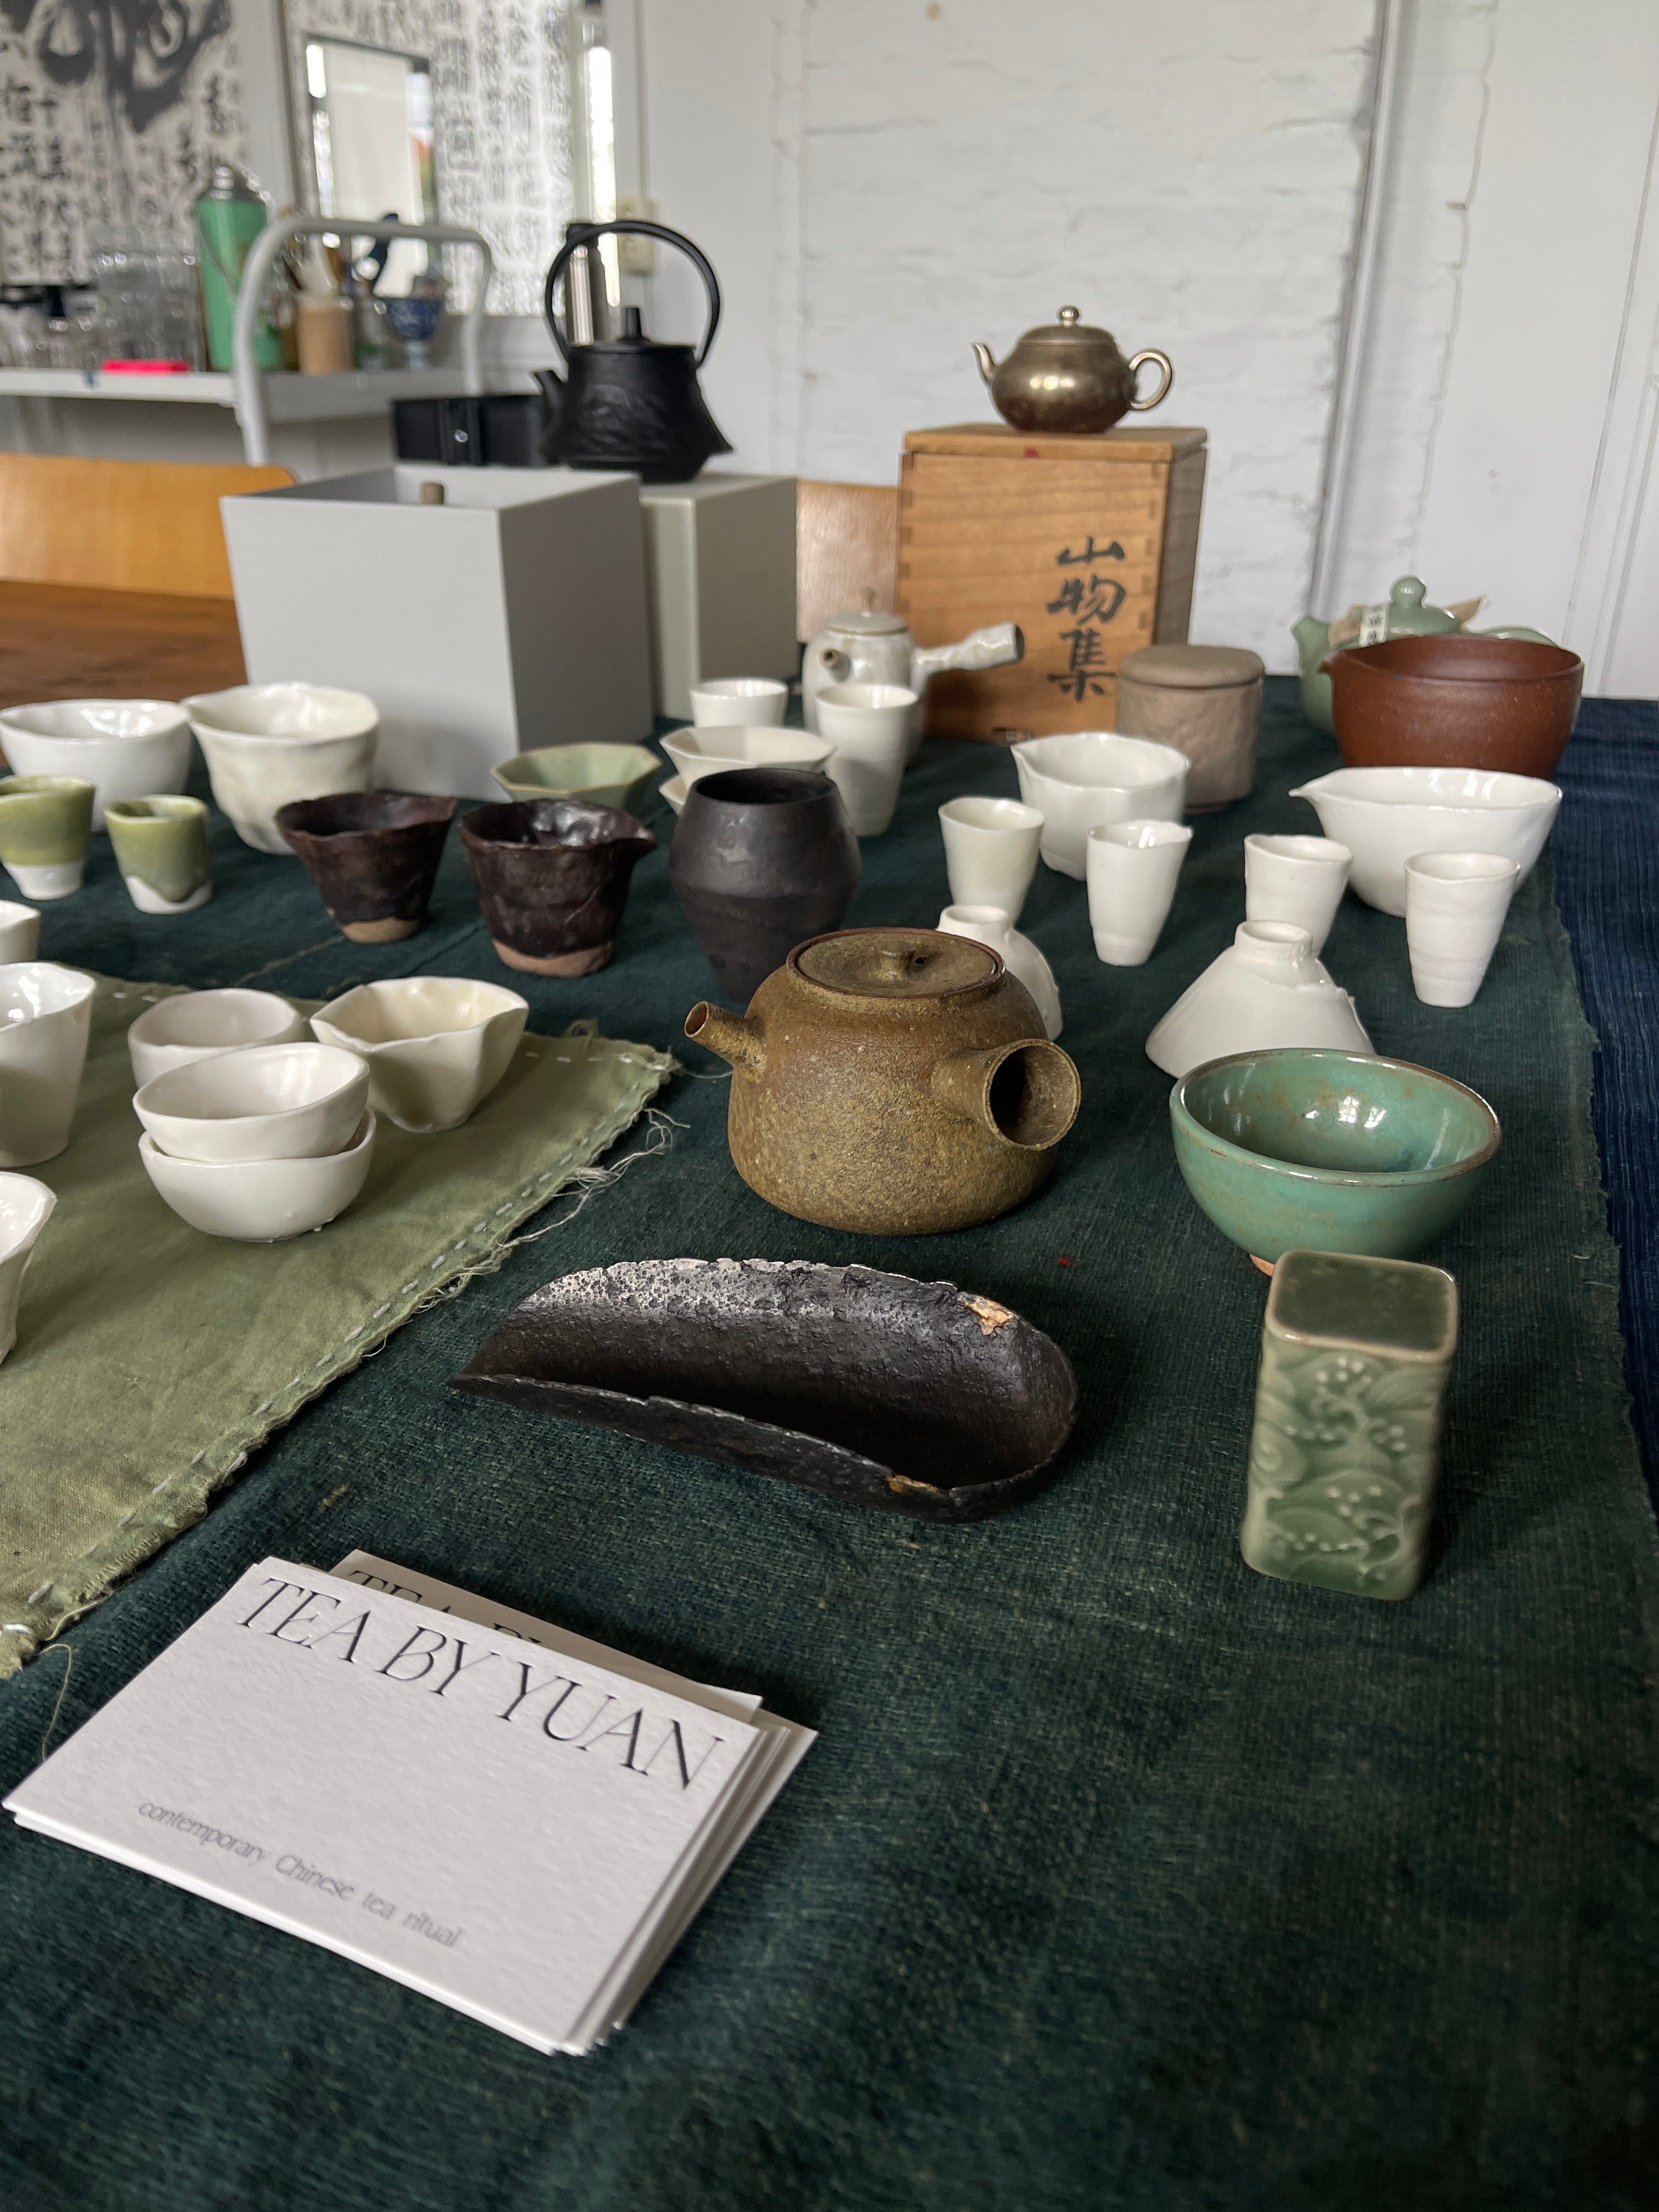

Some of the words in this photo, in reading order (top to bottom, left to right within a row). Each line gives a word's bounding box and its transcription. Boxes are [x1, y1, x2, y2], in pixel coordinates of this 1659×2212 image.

[1045, 535, 1126, 702] 山物集
[235, 1577, 371, 1663] TEA
[374, 1624, 500, 1696] BY
[495, 1662, 724, 1790] YUAN
[138, 1802, 271, 1864] contemporary
[275, 1854, 354, 1900] Chinese
[362, 1892, 396, 1920] tea
[403, 1912, 466, 1947] ritual
